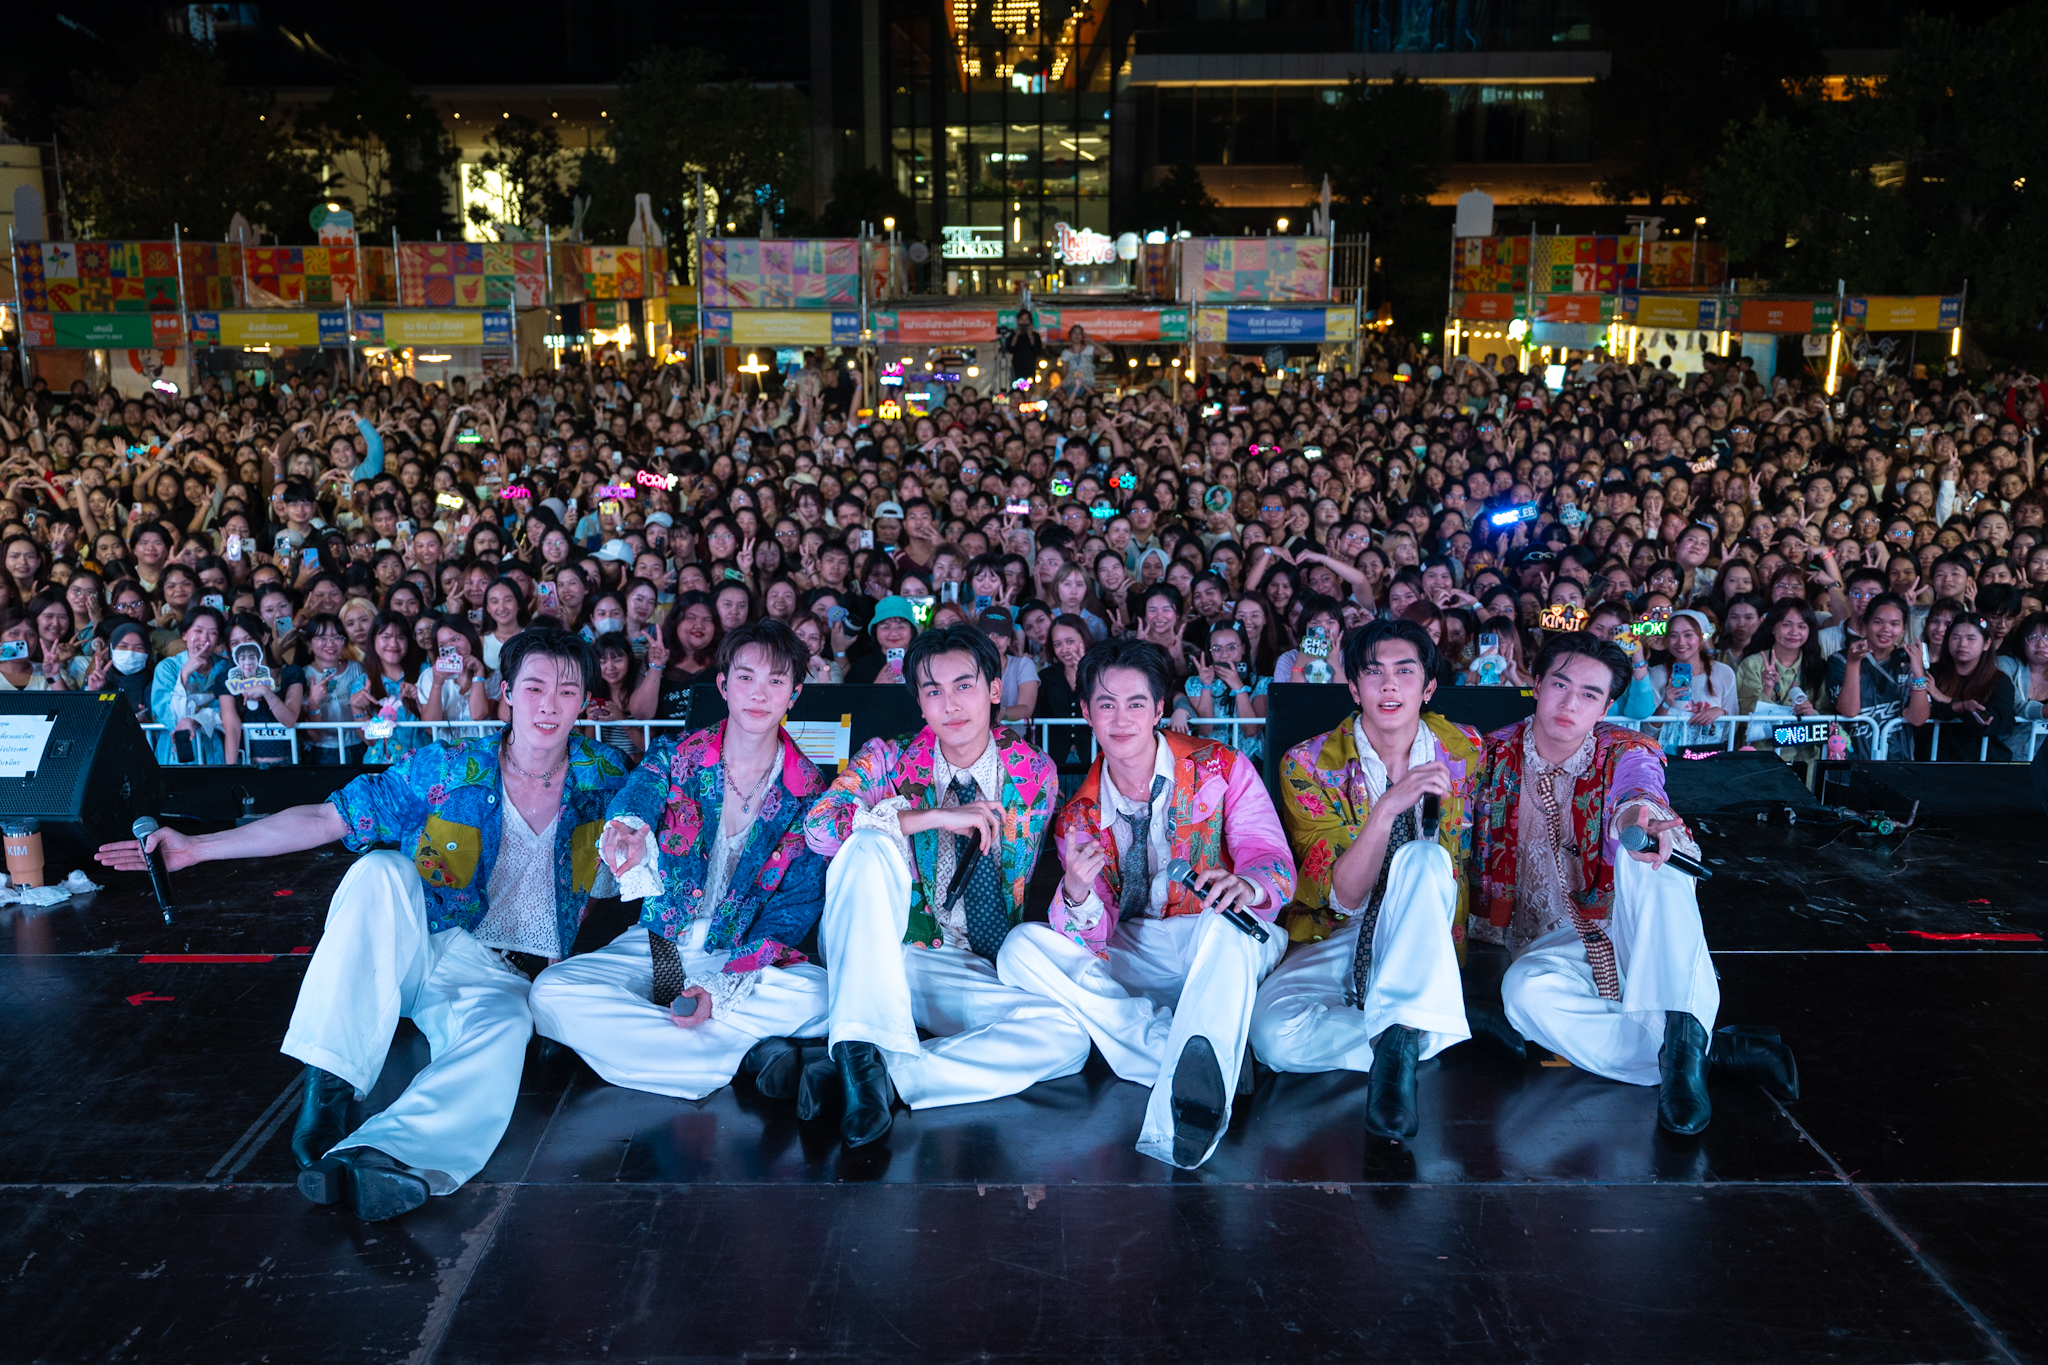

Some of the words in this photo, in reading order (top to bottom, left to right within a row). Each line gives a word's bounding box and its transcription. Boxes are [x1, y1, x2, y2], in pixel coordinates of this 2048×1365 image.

[941, 229, 972, 241] THE
[1691, 459, 1716, 474] GUN
[1541, 613, 1581, 631] KIMJI
[230, 679, 272, 691] VICTOR
[6, 845, 28, 856] KIM
